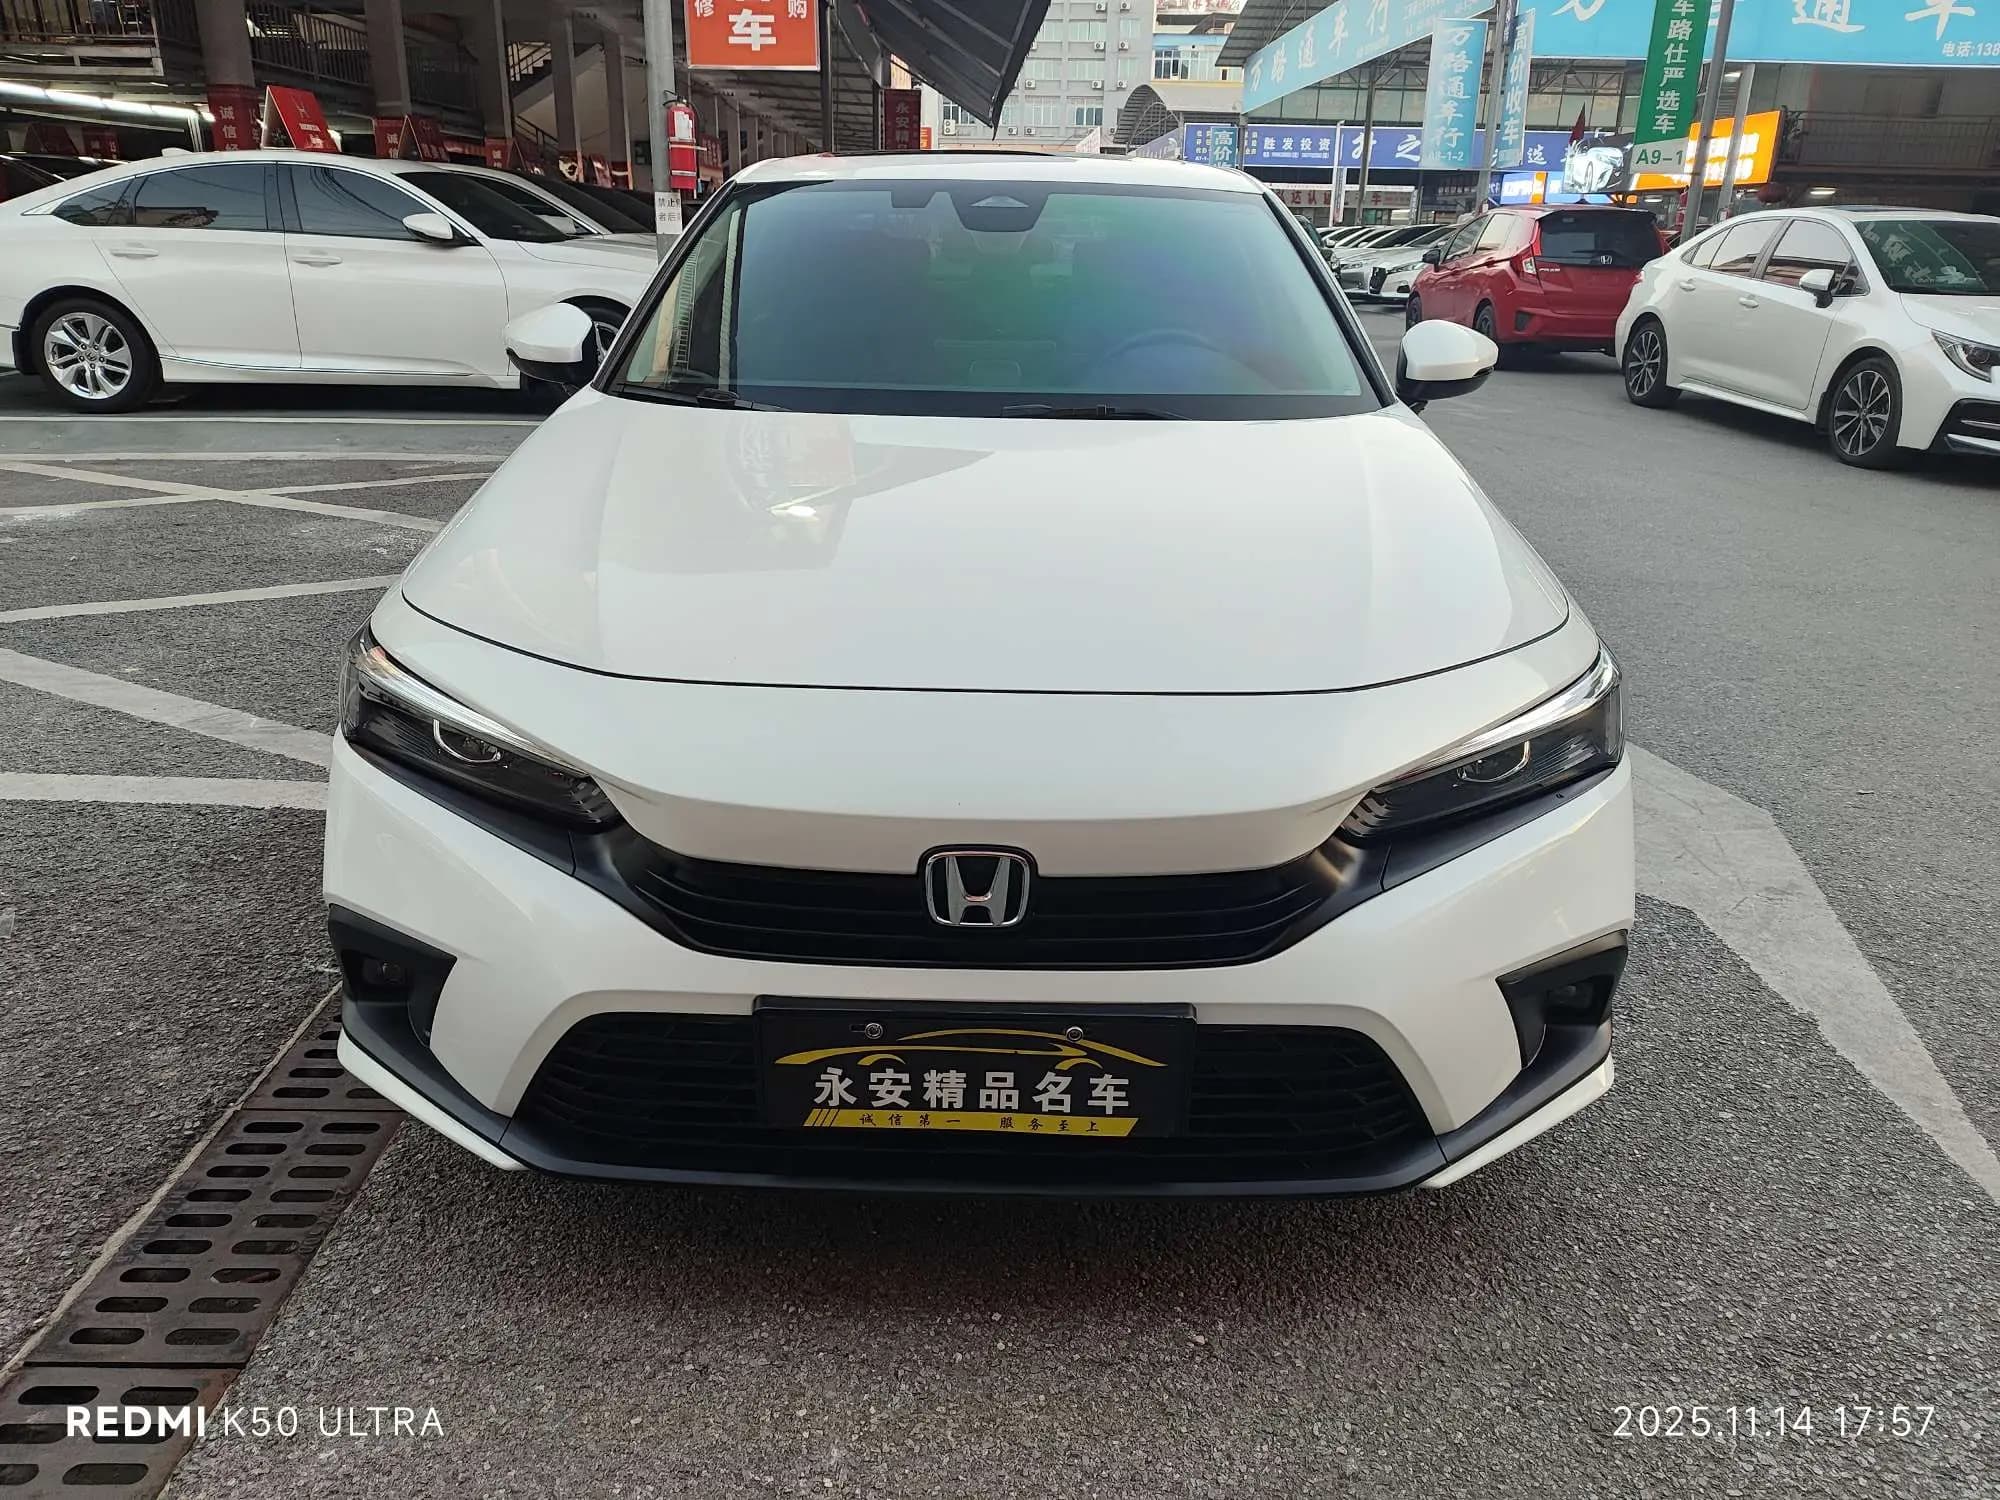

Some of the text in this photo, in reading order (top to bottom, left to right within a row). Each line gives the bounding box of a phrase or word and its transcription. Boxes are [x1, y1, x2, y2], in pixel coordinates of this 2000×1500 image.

[728, 9, 776, 51] 车
[1264, 137, 1331, 151] 胜发投资
[1636, 149, 1683, 165] A9-1
[814, 1067, 1130, 1115] 永安精品名车
[858, 1112, 1101, 1133] 诚信第一 服务至上
